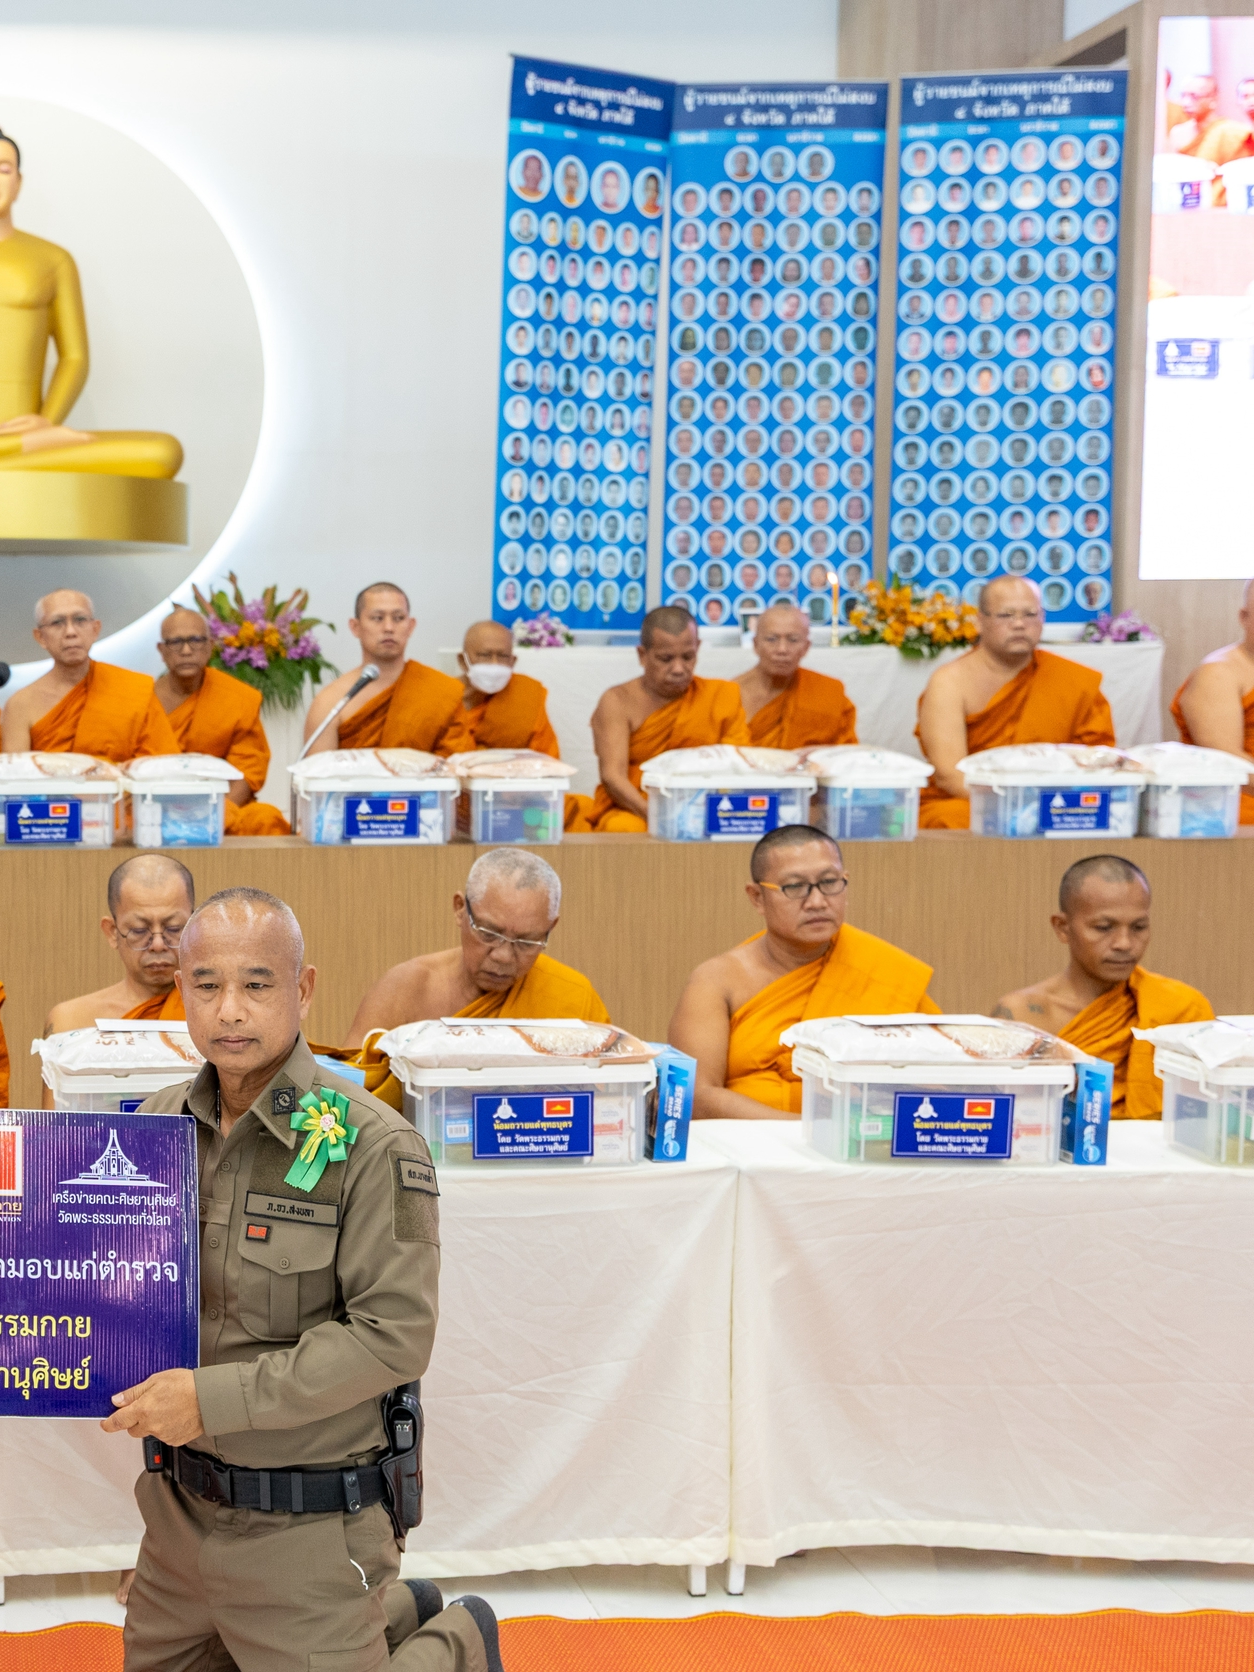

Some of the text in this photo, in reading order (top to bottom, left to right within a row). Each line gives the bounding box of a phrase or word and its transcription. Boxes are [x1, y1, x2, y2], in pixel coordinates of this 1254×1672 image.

[673, 1086, 684, 1119] SERIES
[52, 1190, 177, 1210] เครือข่ายคณะศิษยานุศิษย์
[58, 1209, 171, 1226] วัดพระธรรมกายทั่วโลก
